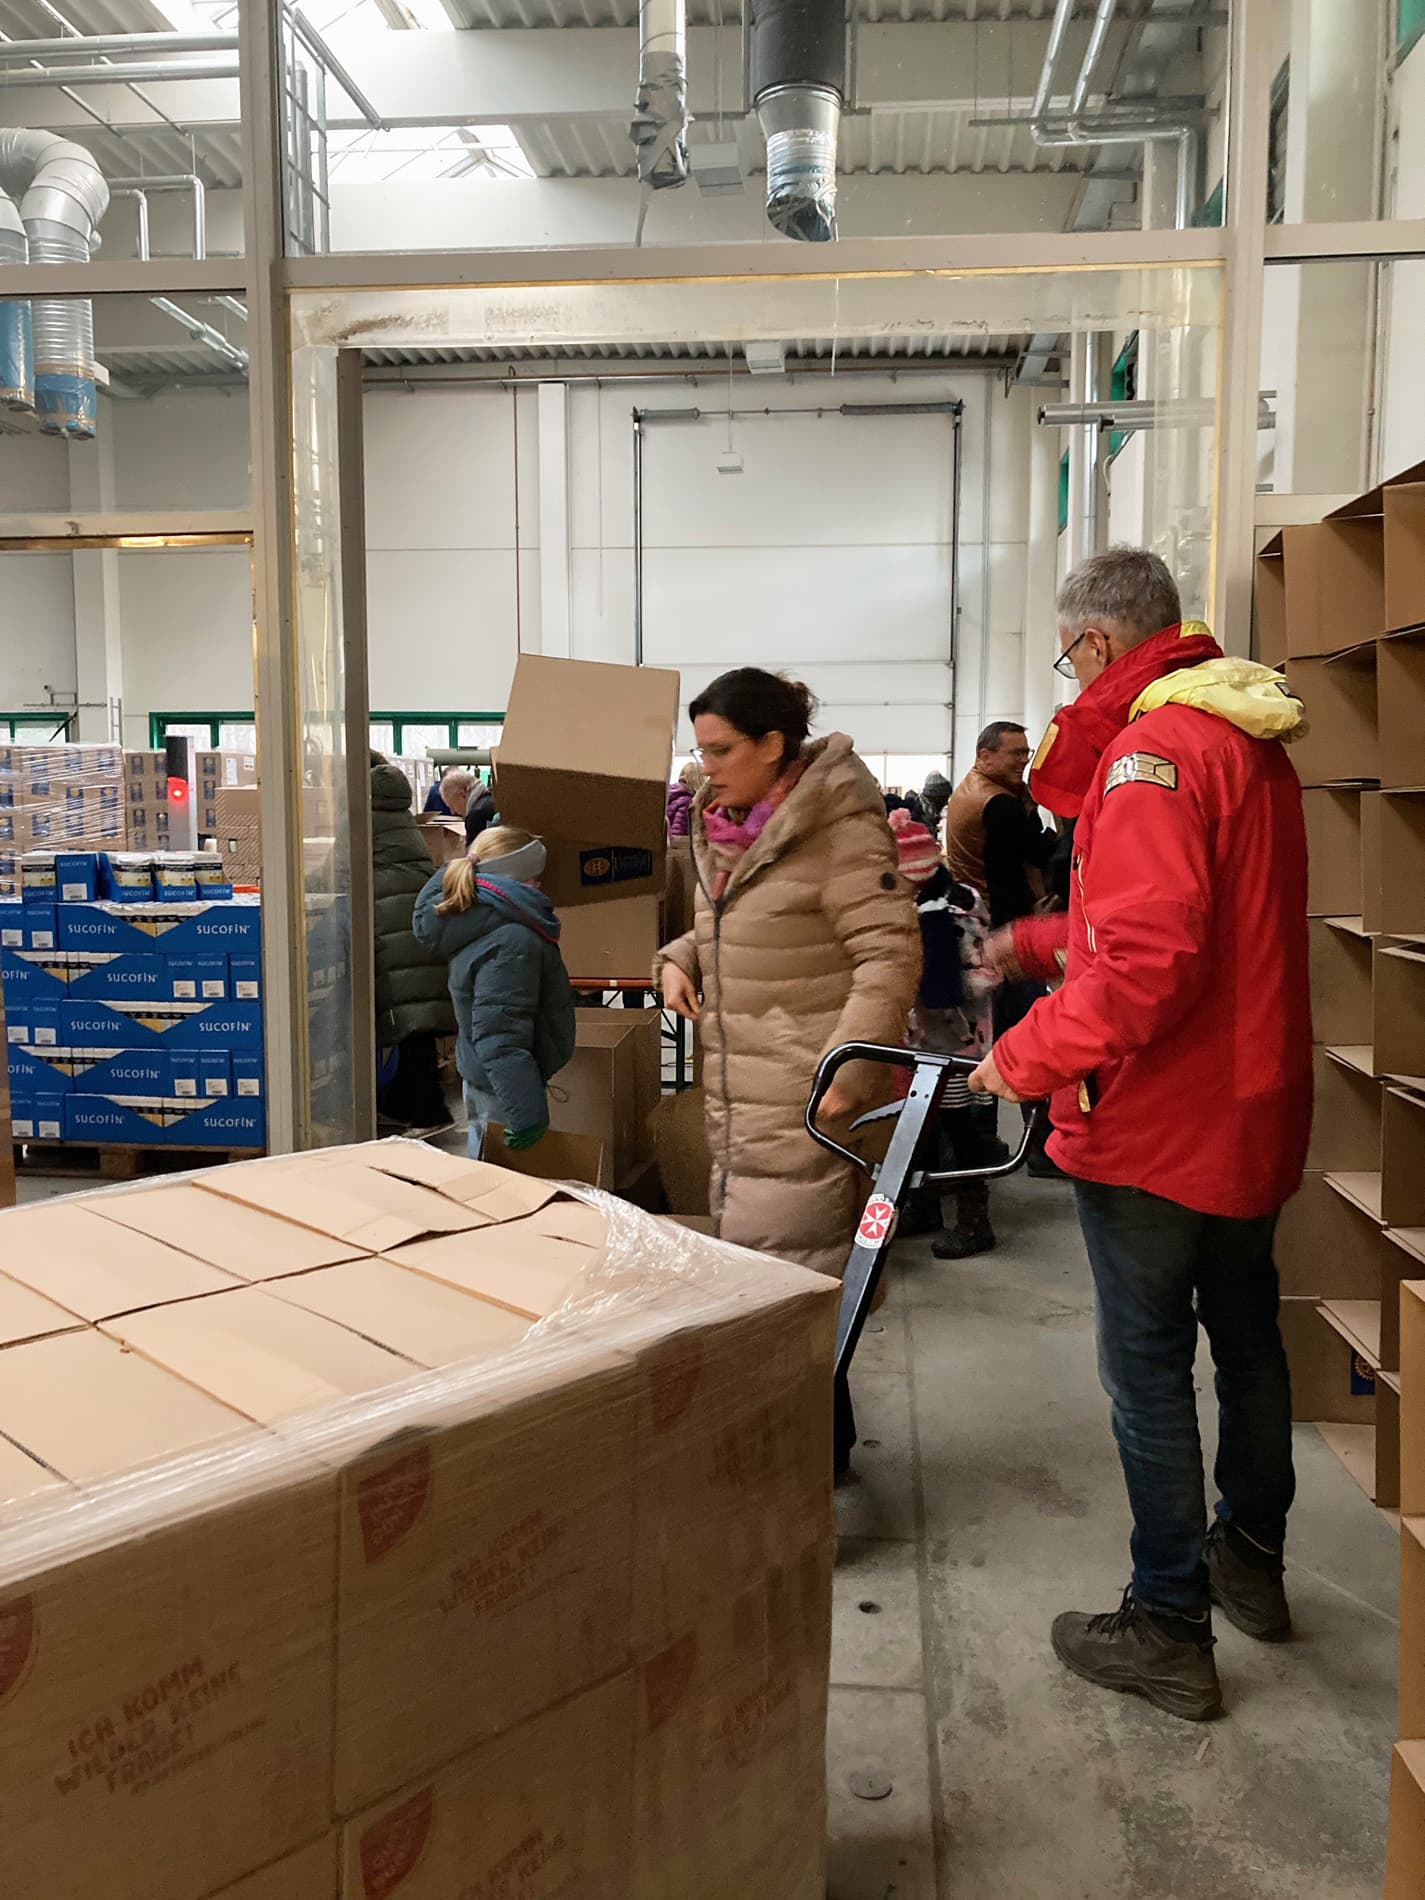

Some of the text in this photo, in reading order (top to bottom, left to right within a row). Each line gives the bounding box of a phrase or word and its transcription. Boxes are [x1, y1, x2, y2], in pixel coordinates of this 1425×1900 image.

[68, 923, 117, 935] SUCOFIN
[196, 923, 248, 935] SUCOFIN
[106, 972, 157, 983] SUCOFIN
[70, 1020, 121, 1032] SUCOFIN
[199, 1020, 251, 1032] SUCOFIN
[110, 1068, 159, 1080] SUCOFIN
[75, 1114, 124, 1126] SUCOFIN
[203, 1116, 256, 1129] SUCOFIN
